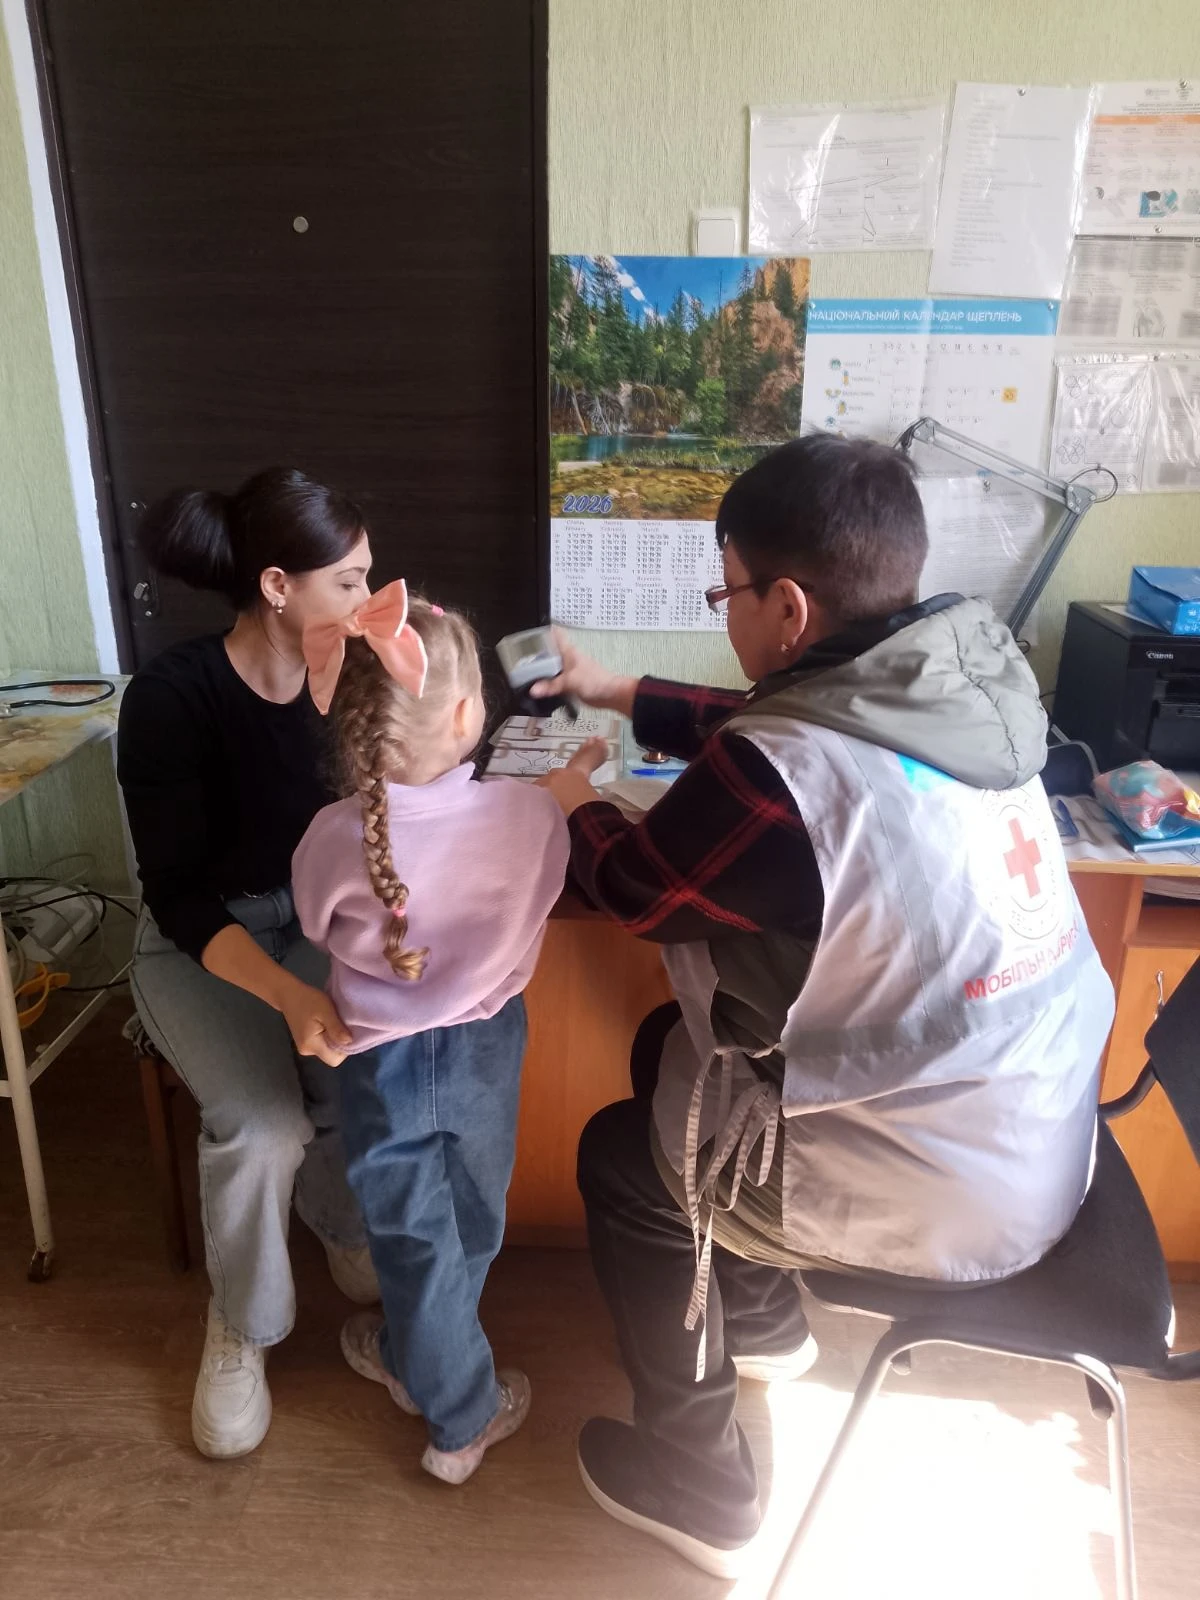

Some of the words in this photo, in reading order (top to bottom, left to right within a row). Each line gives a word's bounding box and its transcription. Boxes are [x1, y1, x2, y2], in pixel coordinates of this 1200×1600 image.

[967, 311, 1022, 323] ЩЕПЛЕНЬ
[563, 495, 613, 513] 2026
[1146, 650, 1174, 659] Canon
